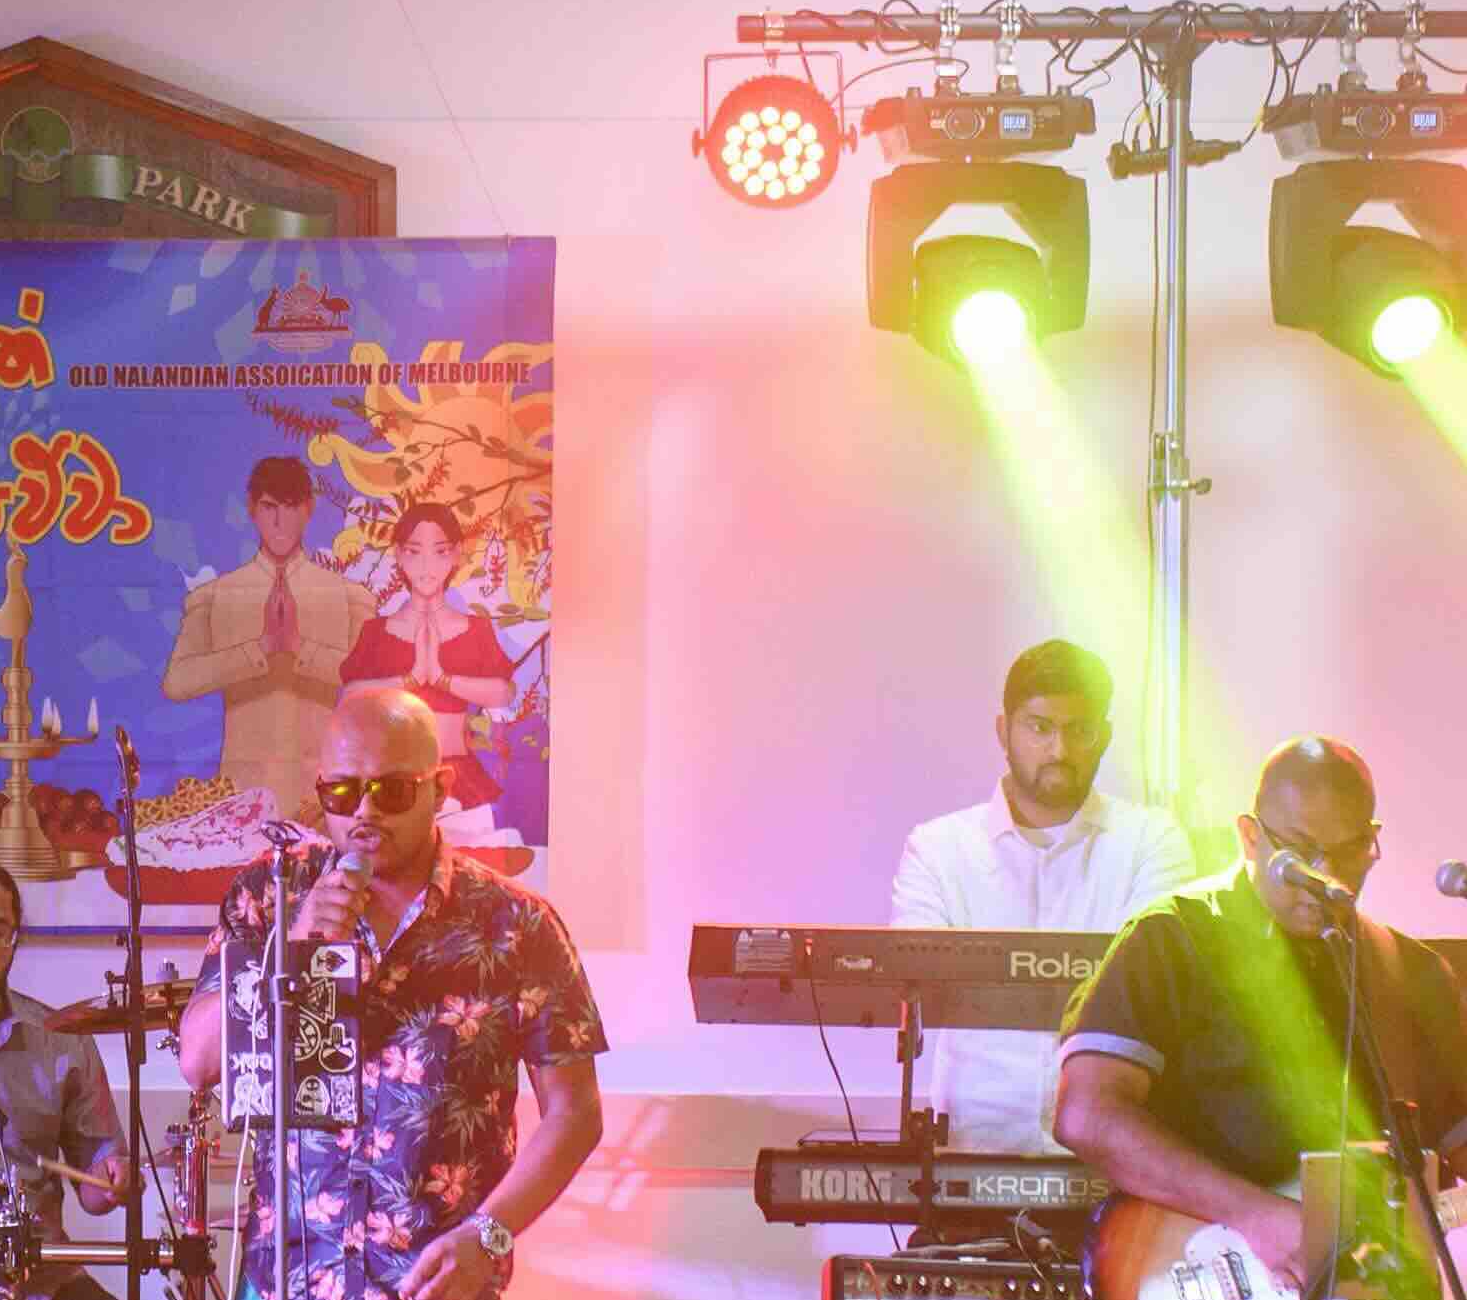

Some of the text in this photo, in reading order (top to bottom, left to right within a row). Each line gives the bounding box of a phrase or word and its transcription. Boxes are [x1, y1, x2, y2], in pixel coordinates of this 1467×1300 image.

[130, 165, 254, 235] PARK
[68, 362, 531, 388] OLD NALANDIAN ASSOICATION OF MELBOURNE
[1009, 950, 1103, 980] Rola
[800, 1168, 1109, 1202] KORG KRONOS
